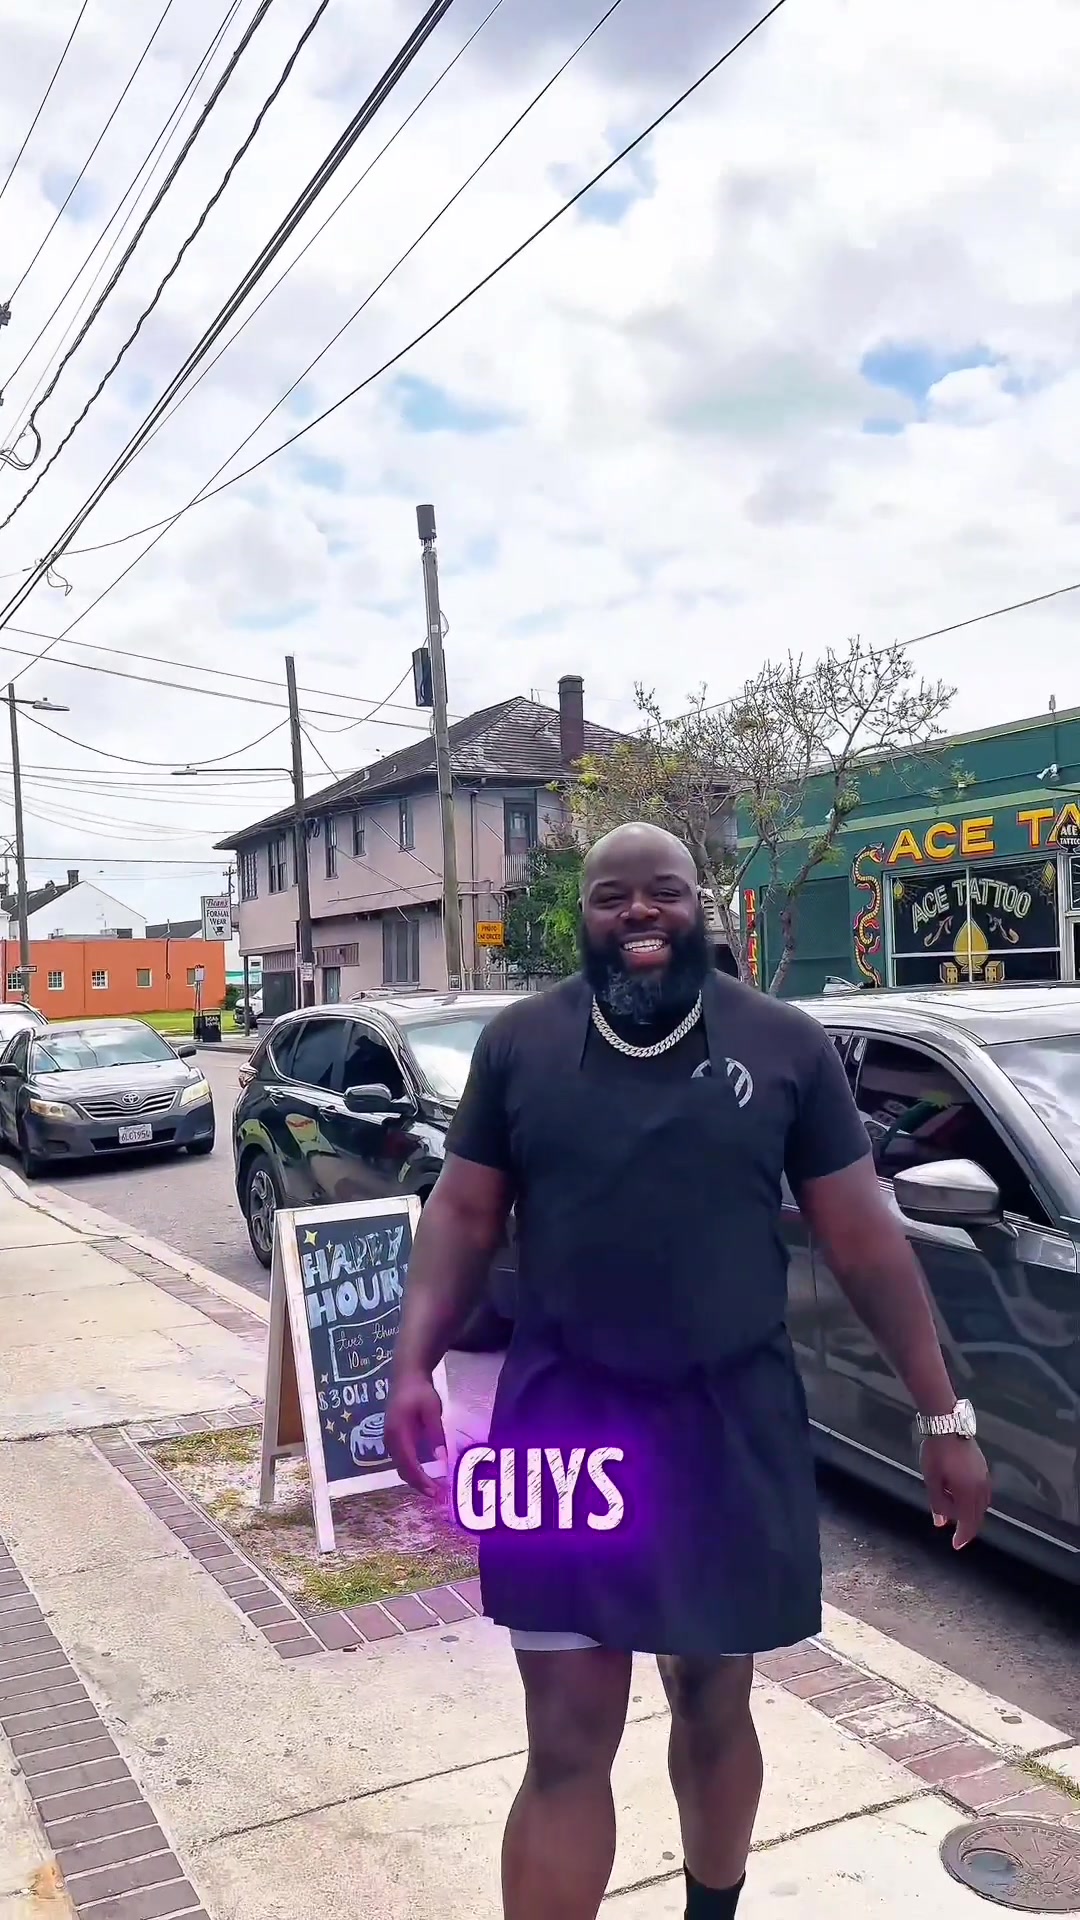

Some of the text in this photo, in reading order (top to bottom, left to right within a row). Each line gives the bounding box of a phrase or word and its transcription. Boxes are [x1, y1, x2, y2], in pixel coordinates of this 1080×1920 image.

[887, 816, 995, 864] ACE
[1060, 824, 1078, 836] ACE
[206, 909, 229, 918] FORMAL
[912, 878, 1031, 933] ACE TATTOO
[300, 1225, 403, 1288] HAPPY
[306, 1267, 403, 1329] HOUR
